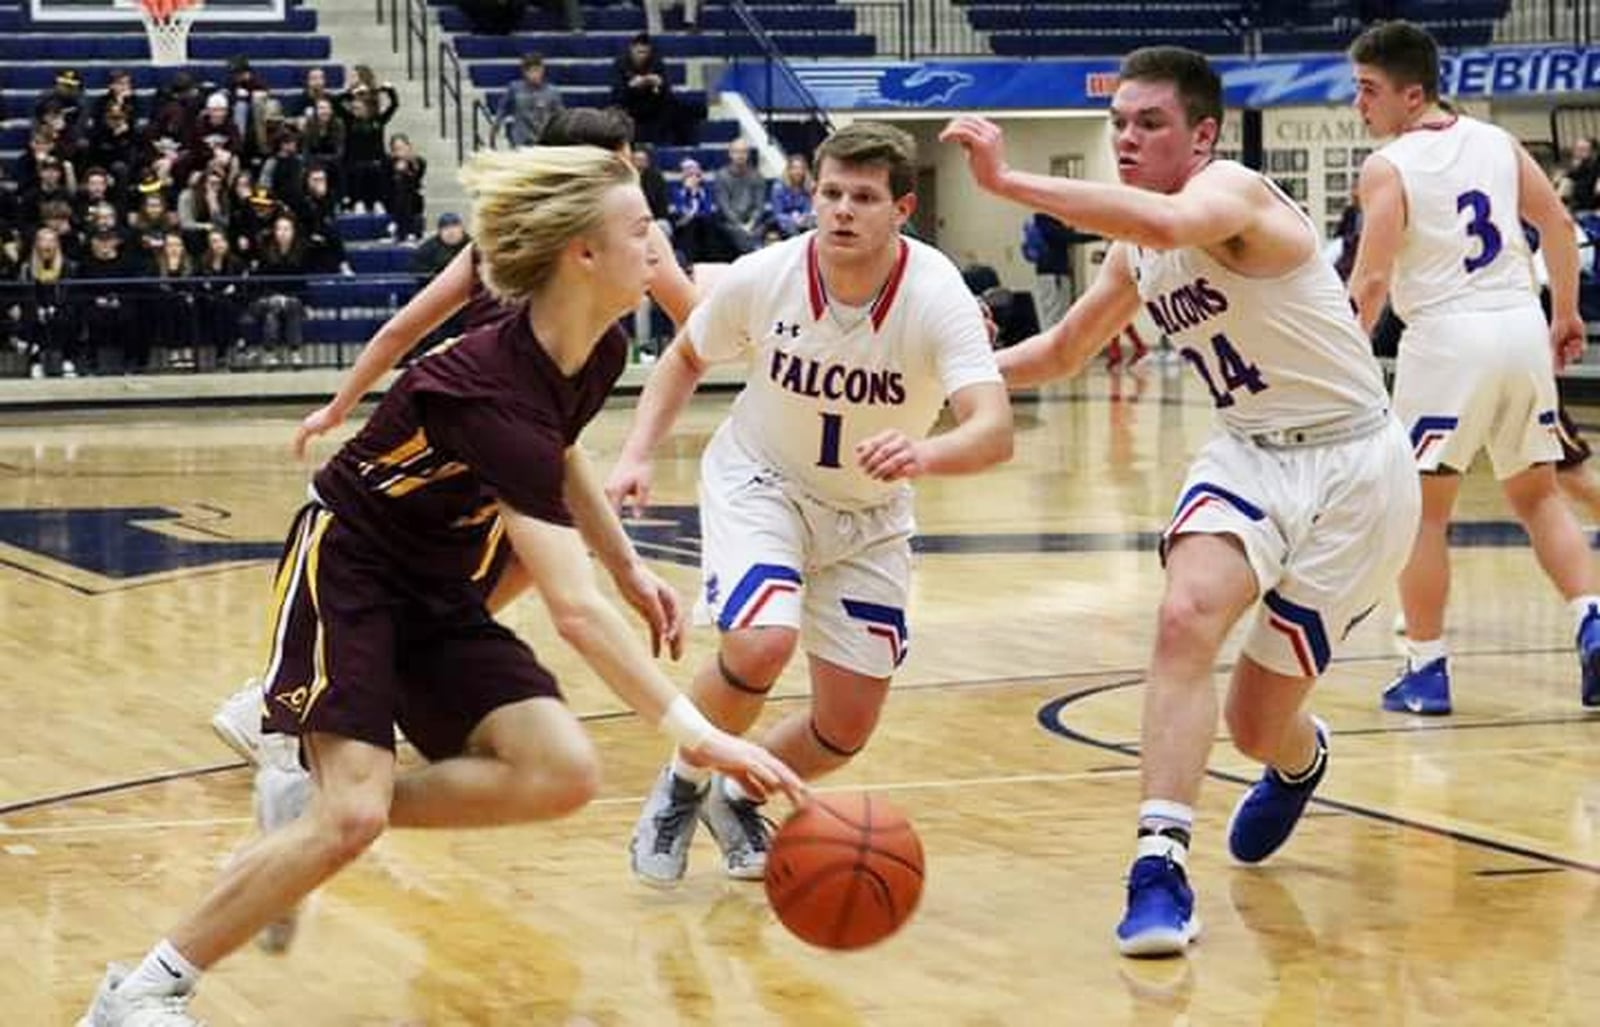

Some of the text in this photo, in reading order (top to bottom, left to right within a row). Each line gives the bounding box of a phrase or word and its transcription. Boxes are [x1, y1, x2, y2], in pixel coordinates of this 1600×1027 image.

[1456, 189, 1503, 274] 3
[769, 349, 906, 405] FALCONS
[1180, 333, 1269, 409] 14
[815, 412, 843, 469] 1
